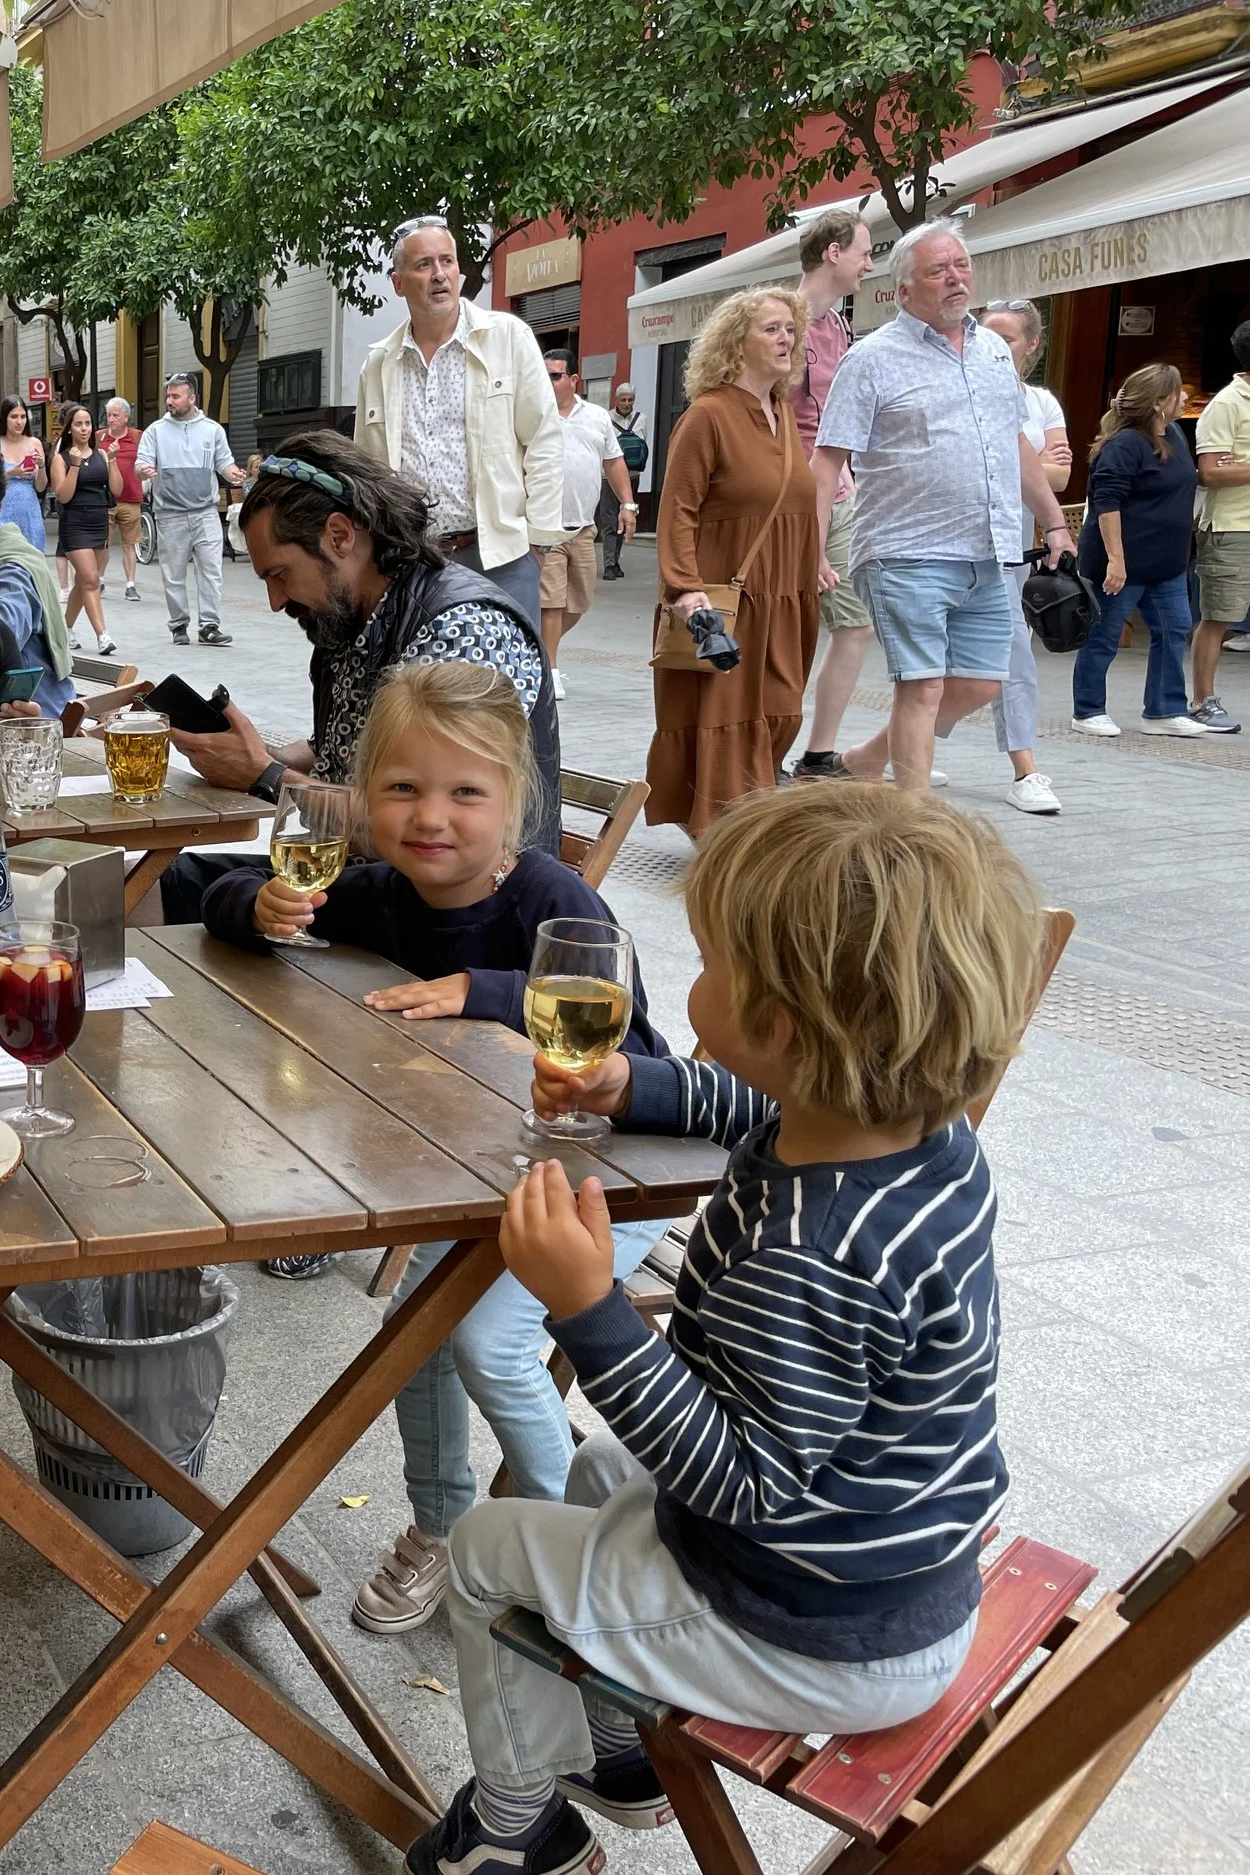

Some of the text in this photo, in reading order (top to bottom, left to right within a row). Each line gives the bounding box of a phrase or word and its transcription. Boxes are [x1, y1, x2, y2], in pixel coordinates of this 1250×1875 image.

[1038, 231, 1148, 283] CASA FUNES
[642, 312, 675, 328] Cruzcampo
